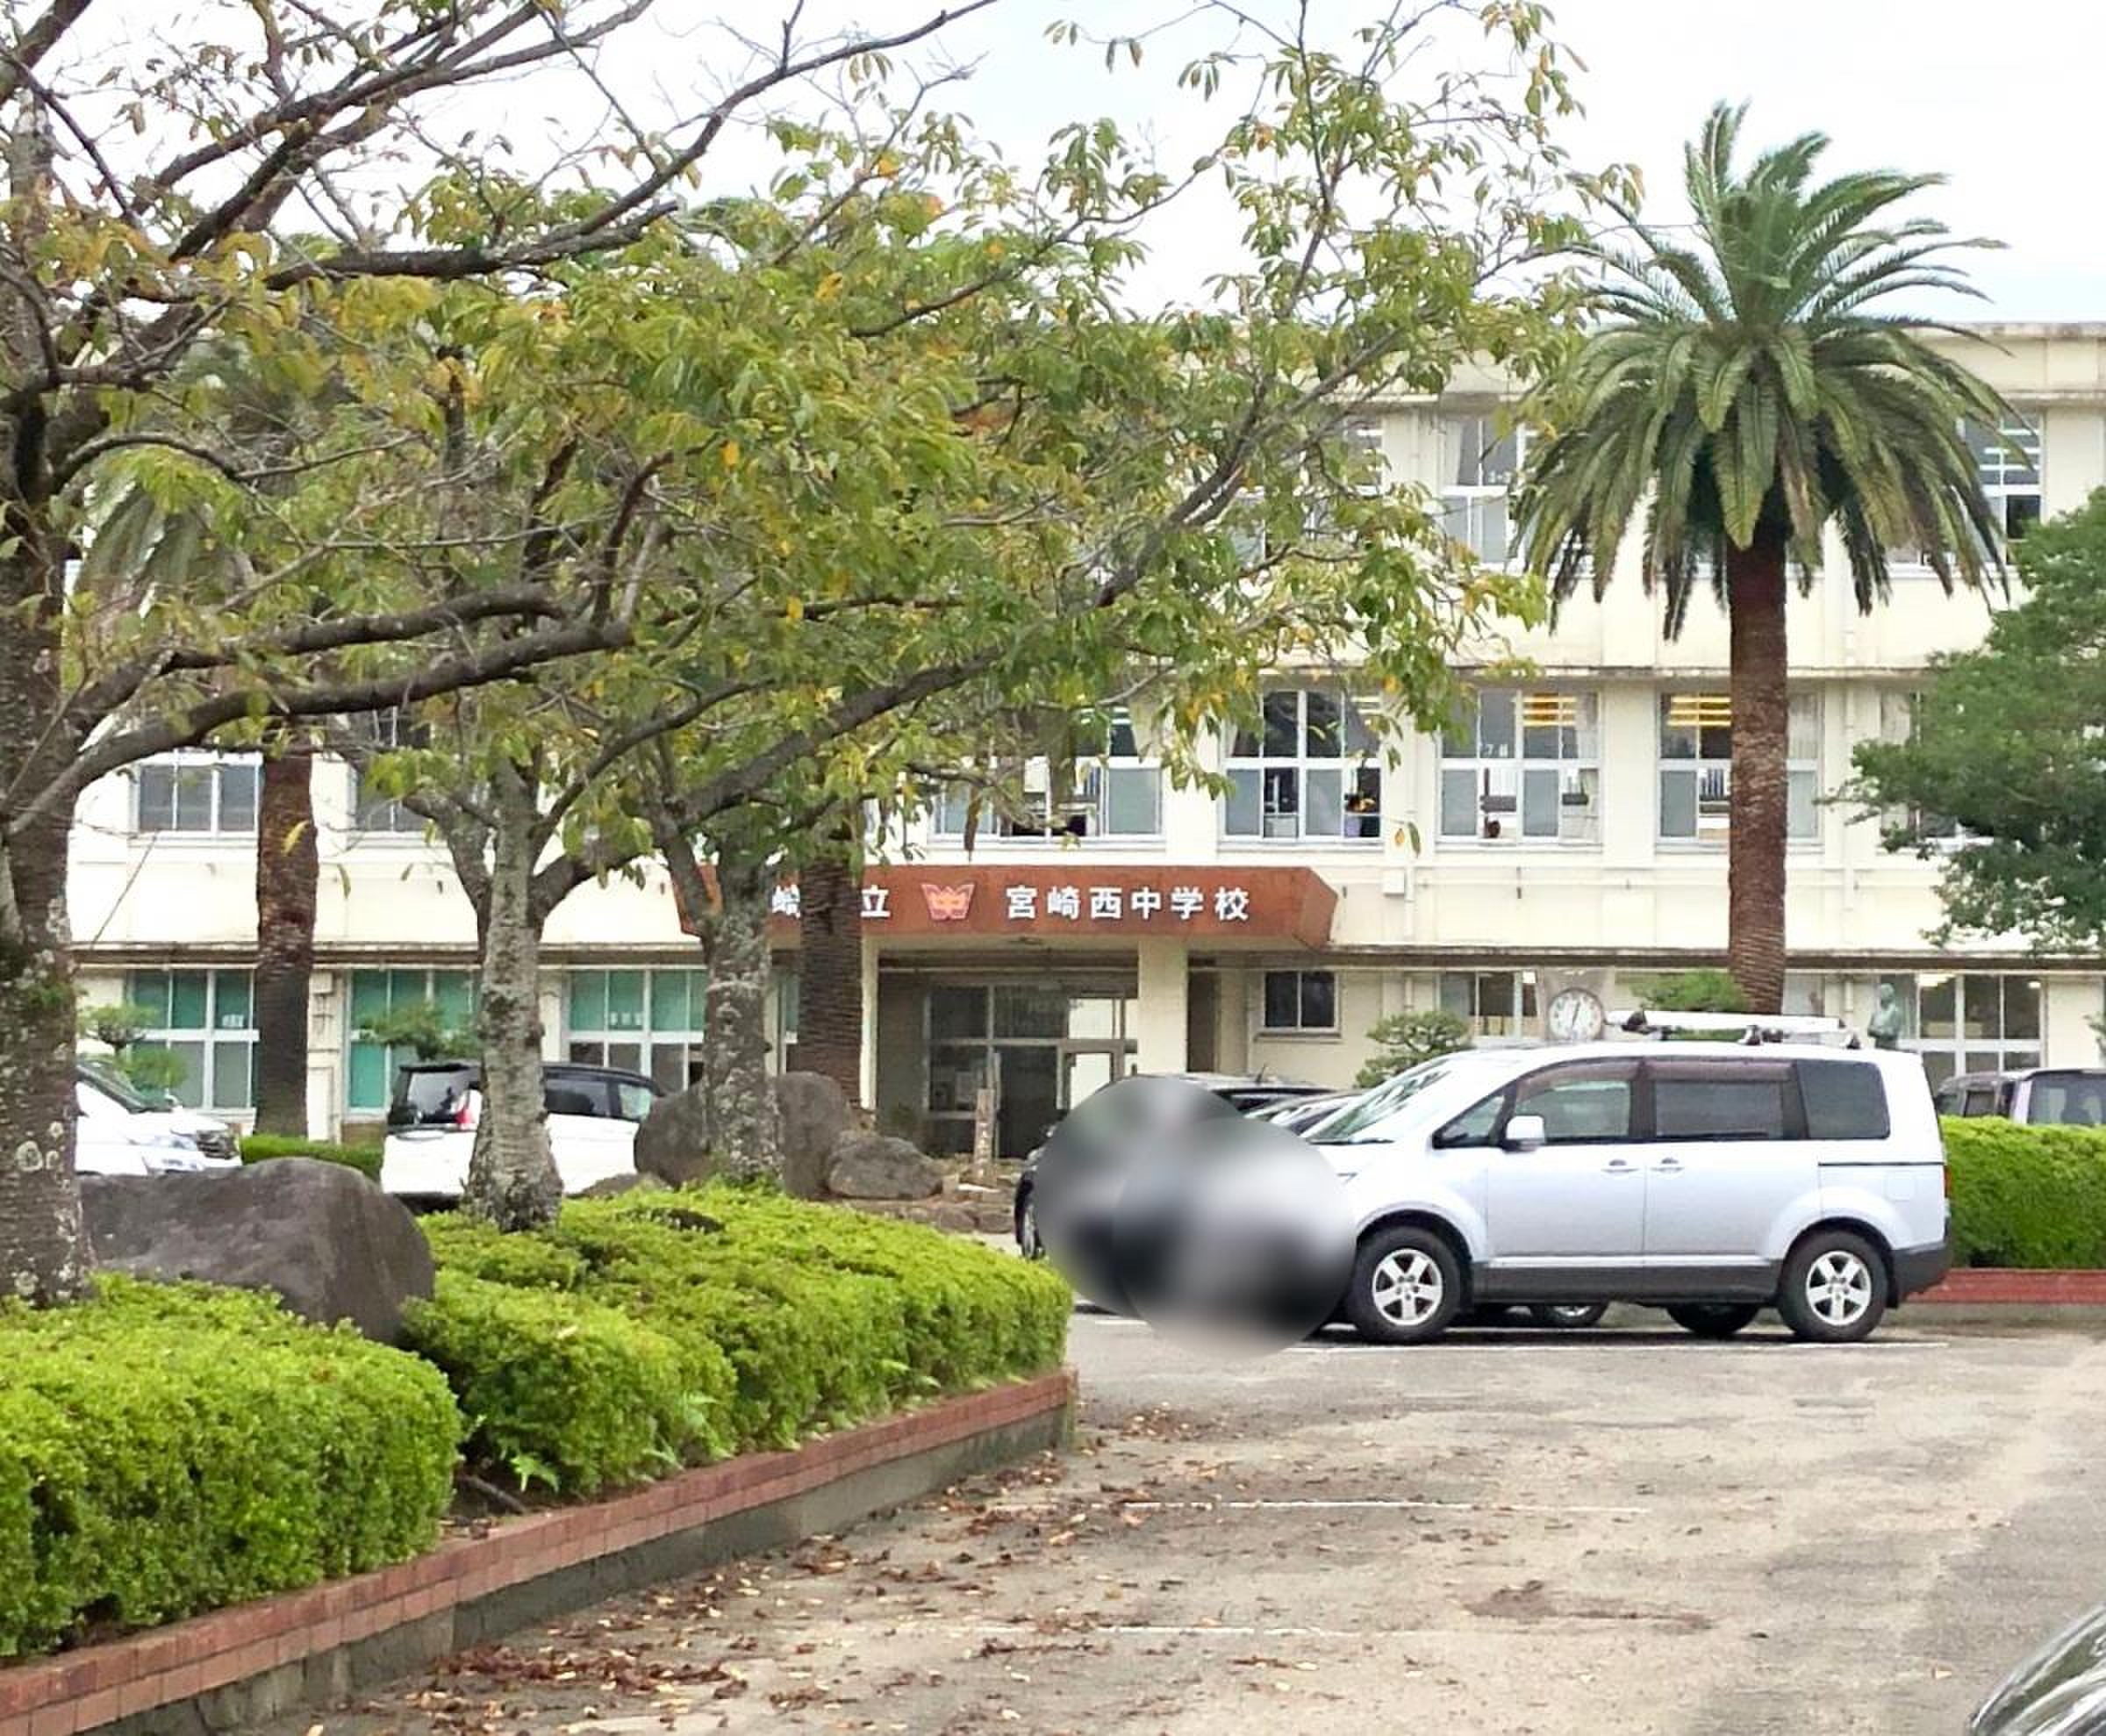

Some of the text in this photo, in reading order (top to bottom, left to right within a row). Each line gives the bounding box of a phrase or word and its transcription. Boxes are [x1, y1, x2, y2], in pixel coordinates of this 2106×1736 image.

[771, 884, 1250, 920] 崎立 宮崎西中学校
